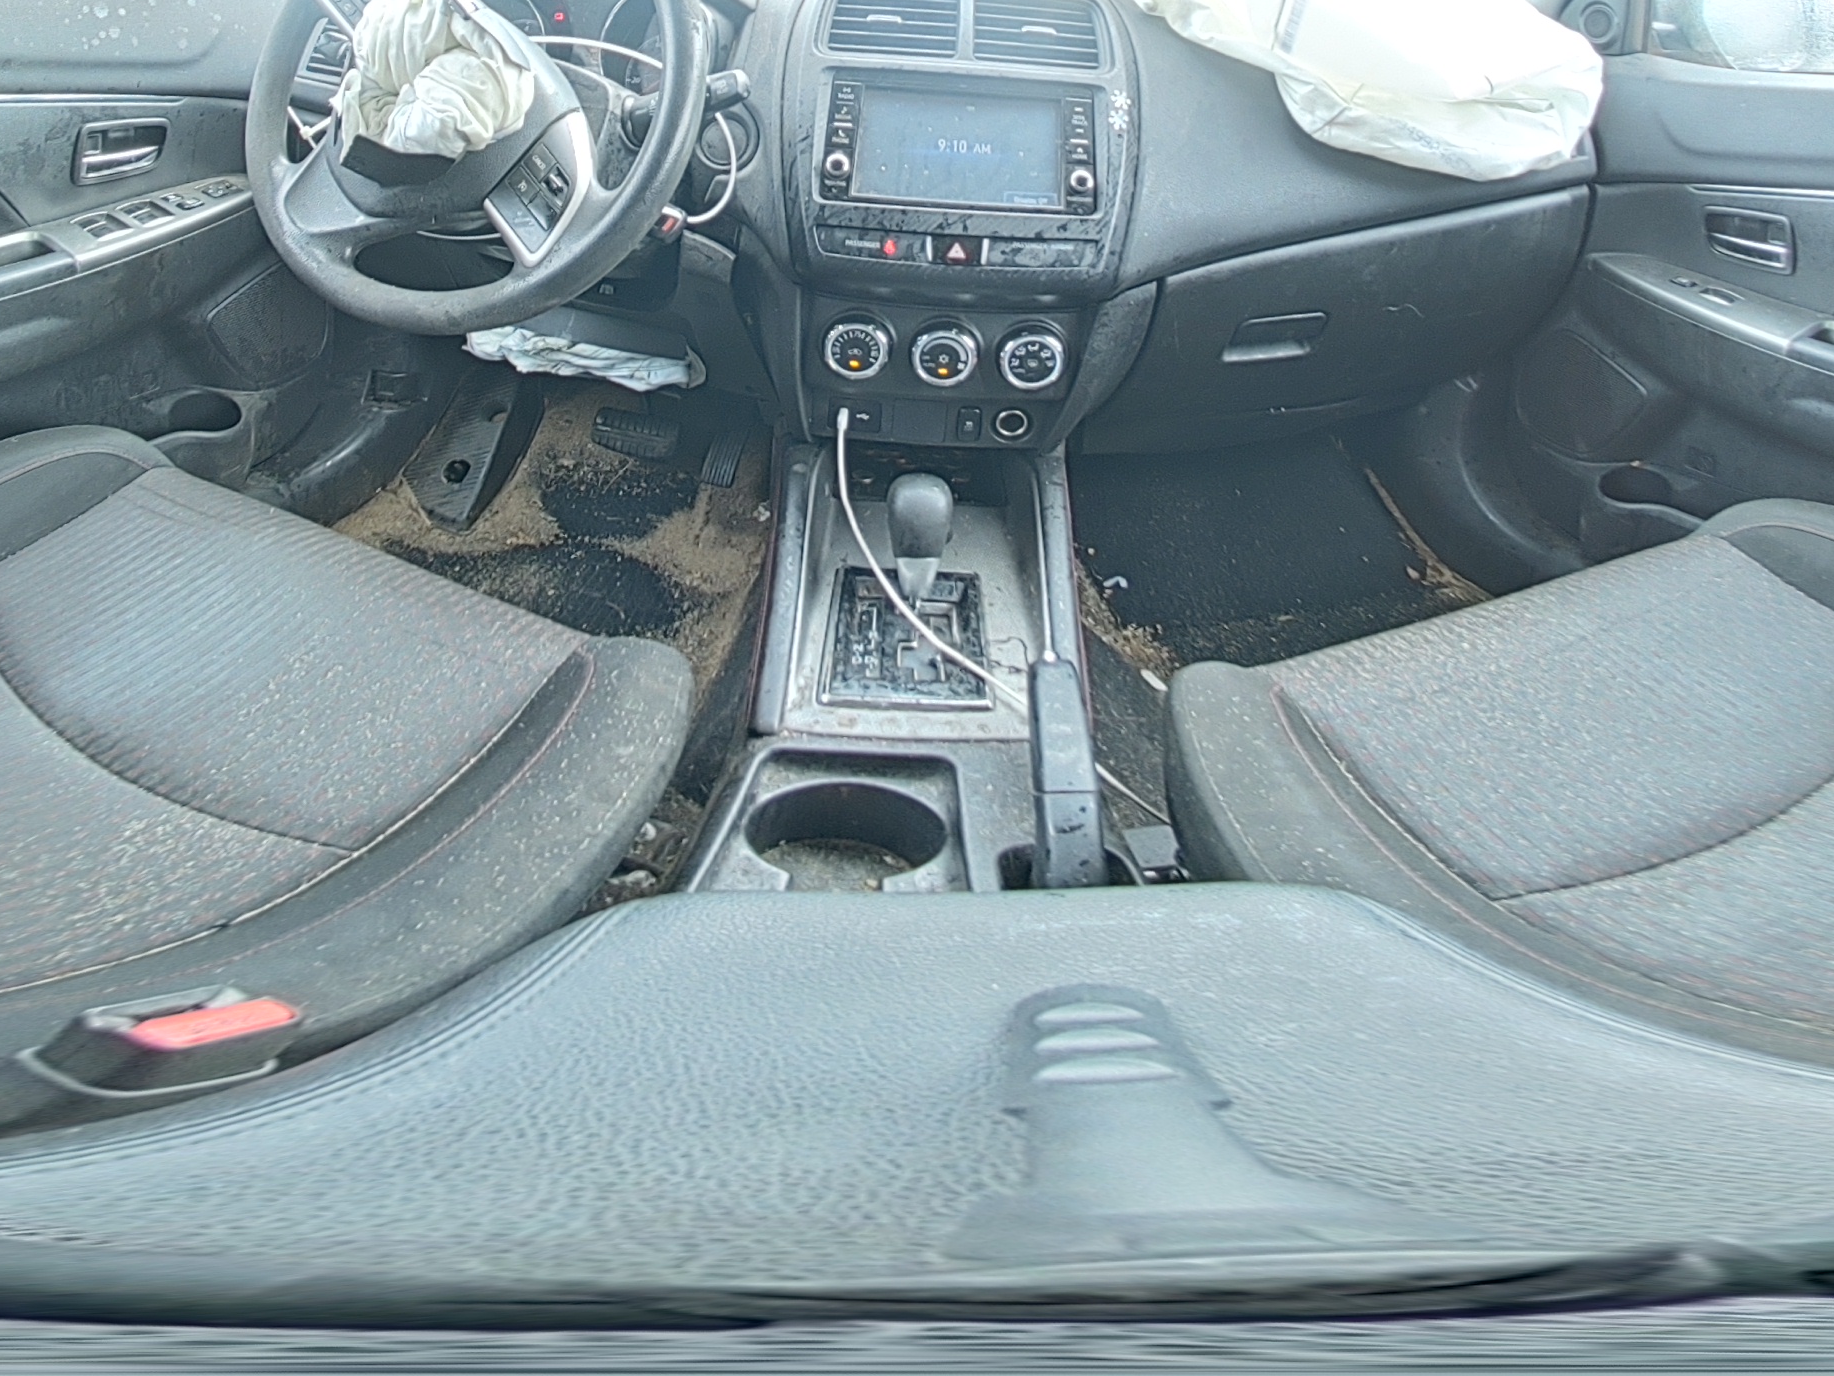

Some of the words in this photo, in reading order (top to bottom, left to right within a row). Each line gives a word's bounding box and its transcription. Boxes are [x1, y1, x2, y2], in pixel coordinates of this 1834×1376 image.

[938, 139, 967, 153] 9:10
[973, 143, 992, 155] AM
[845, 239, 881, 249] PASSENGER
